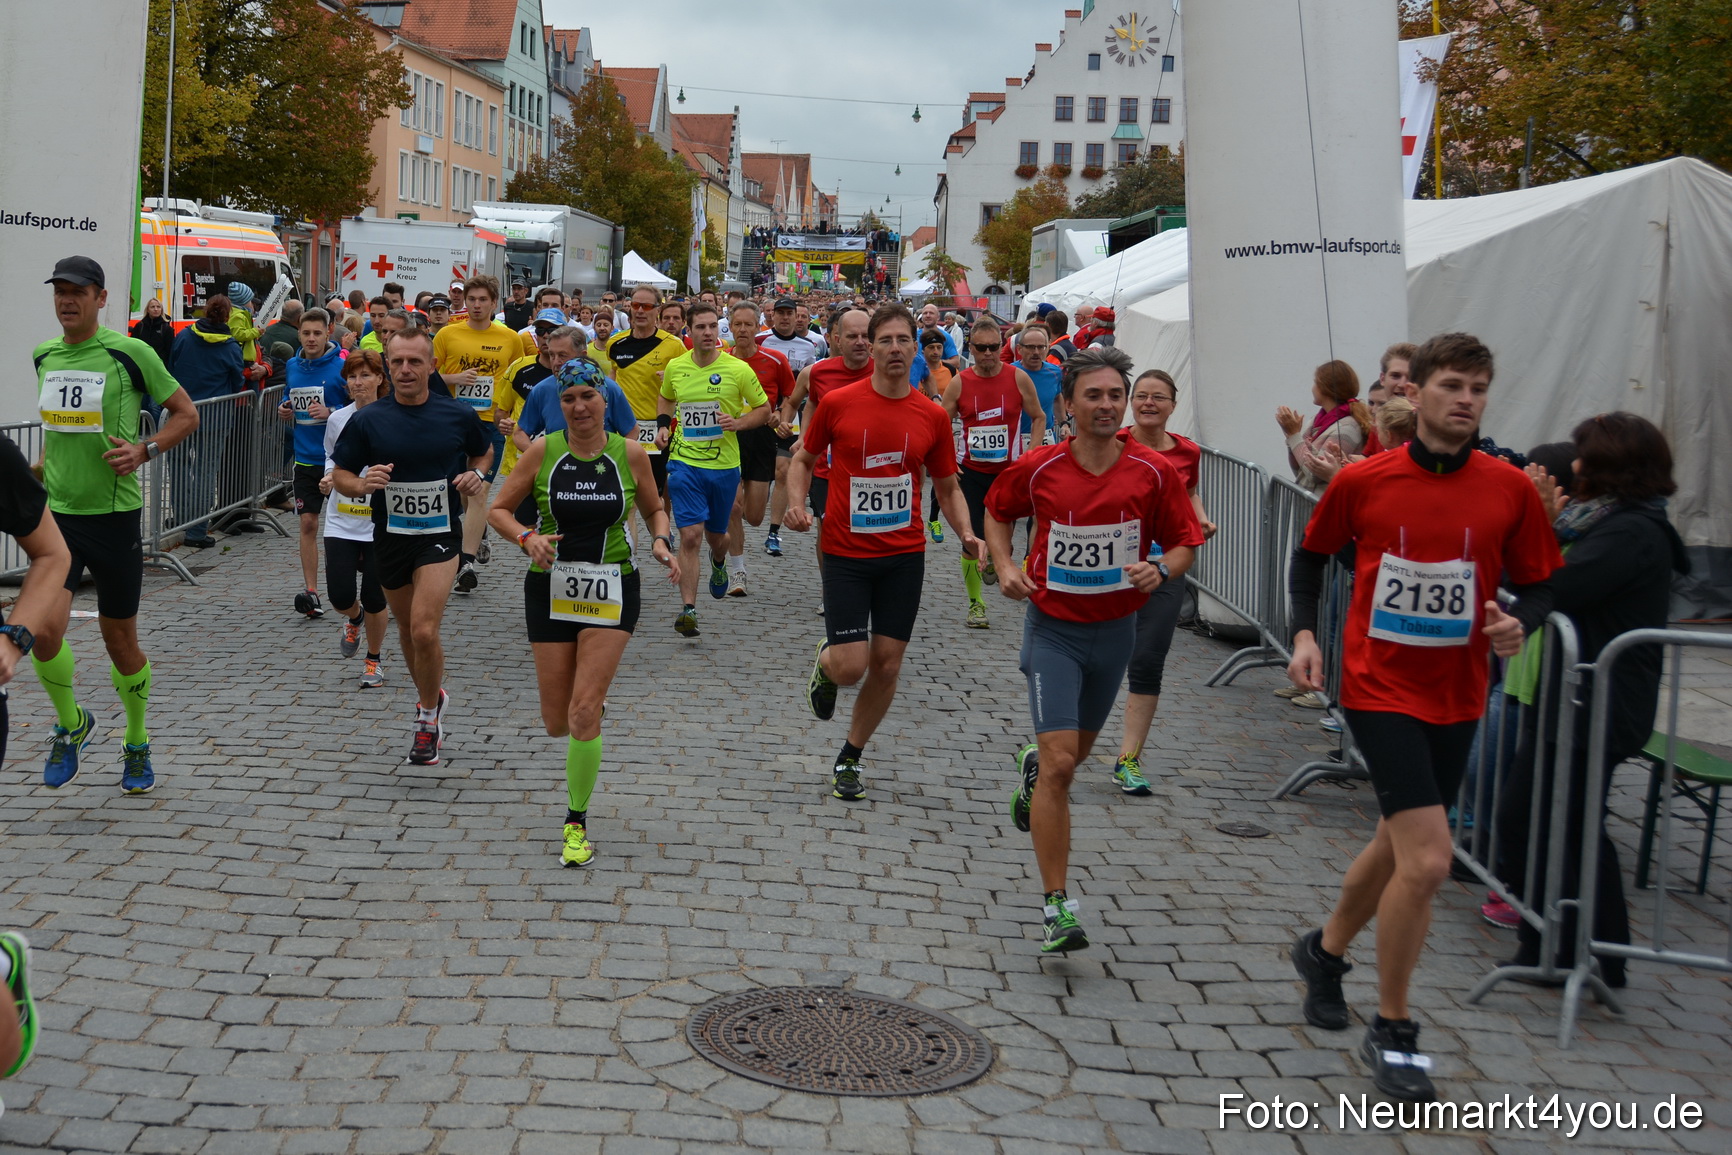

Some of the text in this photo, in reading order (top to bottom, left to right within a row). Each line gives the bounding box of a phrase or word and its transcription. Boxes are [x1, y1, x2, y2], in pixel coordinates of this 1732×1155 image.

[0, 210, 97, 232] laufsport.de
[1225, 238, 1401, 258] www.bmw-laufsport.de
[398, 255, 440, 265] Bayerisches
[804, 253, 835, 261] START
[397, 264, 417, 272] Rotes
[396, 273, 417, 281] Kreuz
[59, 385, 83, 408] 18
[459, 385, 490, 398] 2732
[52, 414, 86, 424] Thomas
[684, 410, 717, 426] 2671
[972, 434, 1005, 449] 2199
[576, 482, 597, 490] DAV
[556, 491, 617, 501] Röthenbach
[858, 489, 908, 512] 2610
[392, 494, 443, 515] 2654
[406, 520, 429, 528] Klaus
[866, 515, 898, 526] Berthold
[1072, 532, 1110, 540] Neumarkt
[1054, 540, 1114, 568] 2231
[554, 565, 576, 574] PARTL
[1382, 562, 1460, 580] PARTL Neumarkt
[1064, 572, 1105, 584] Thomas
[566, 576, 608, 601] 370
[1384, 578, 1466, 615] 2138
[573, 604, 600, 615] Ulrike
[1400, 618, 1443, 635] Tobias
